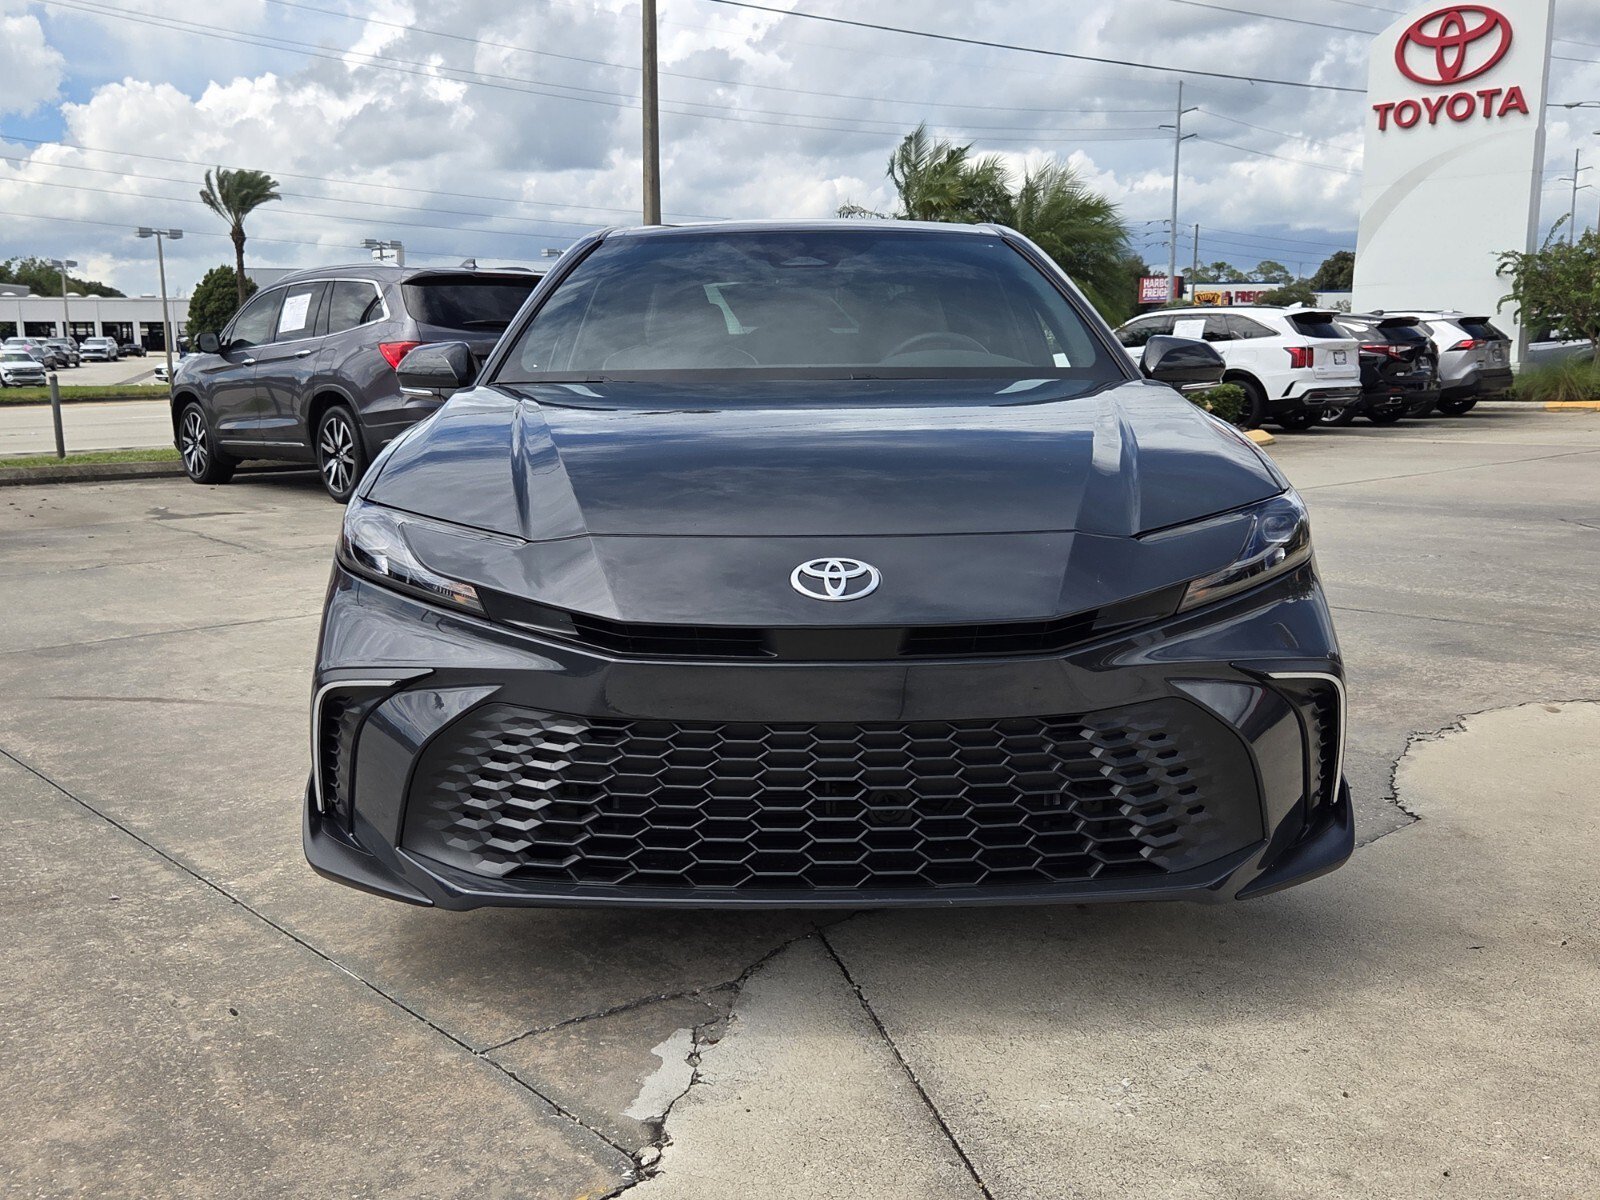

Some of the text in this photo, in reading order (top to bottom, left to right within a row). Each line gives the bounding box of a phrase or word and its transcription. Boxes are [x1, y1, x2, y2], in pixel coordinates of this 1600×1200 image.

[1373, 86, 1529, 131] TOYOTA
[1143, 278, 1170, 288] HARBO
[1142, 288, 1169, 298] FREIGH
